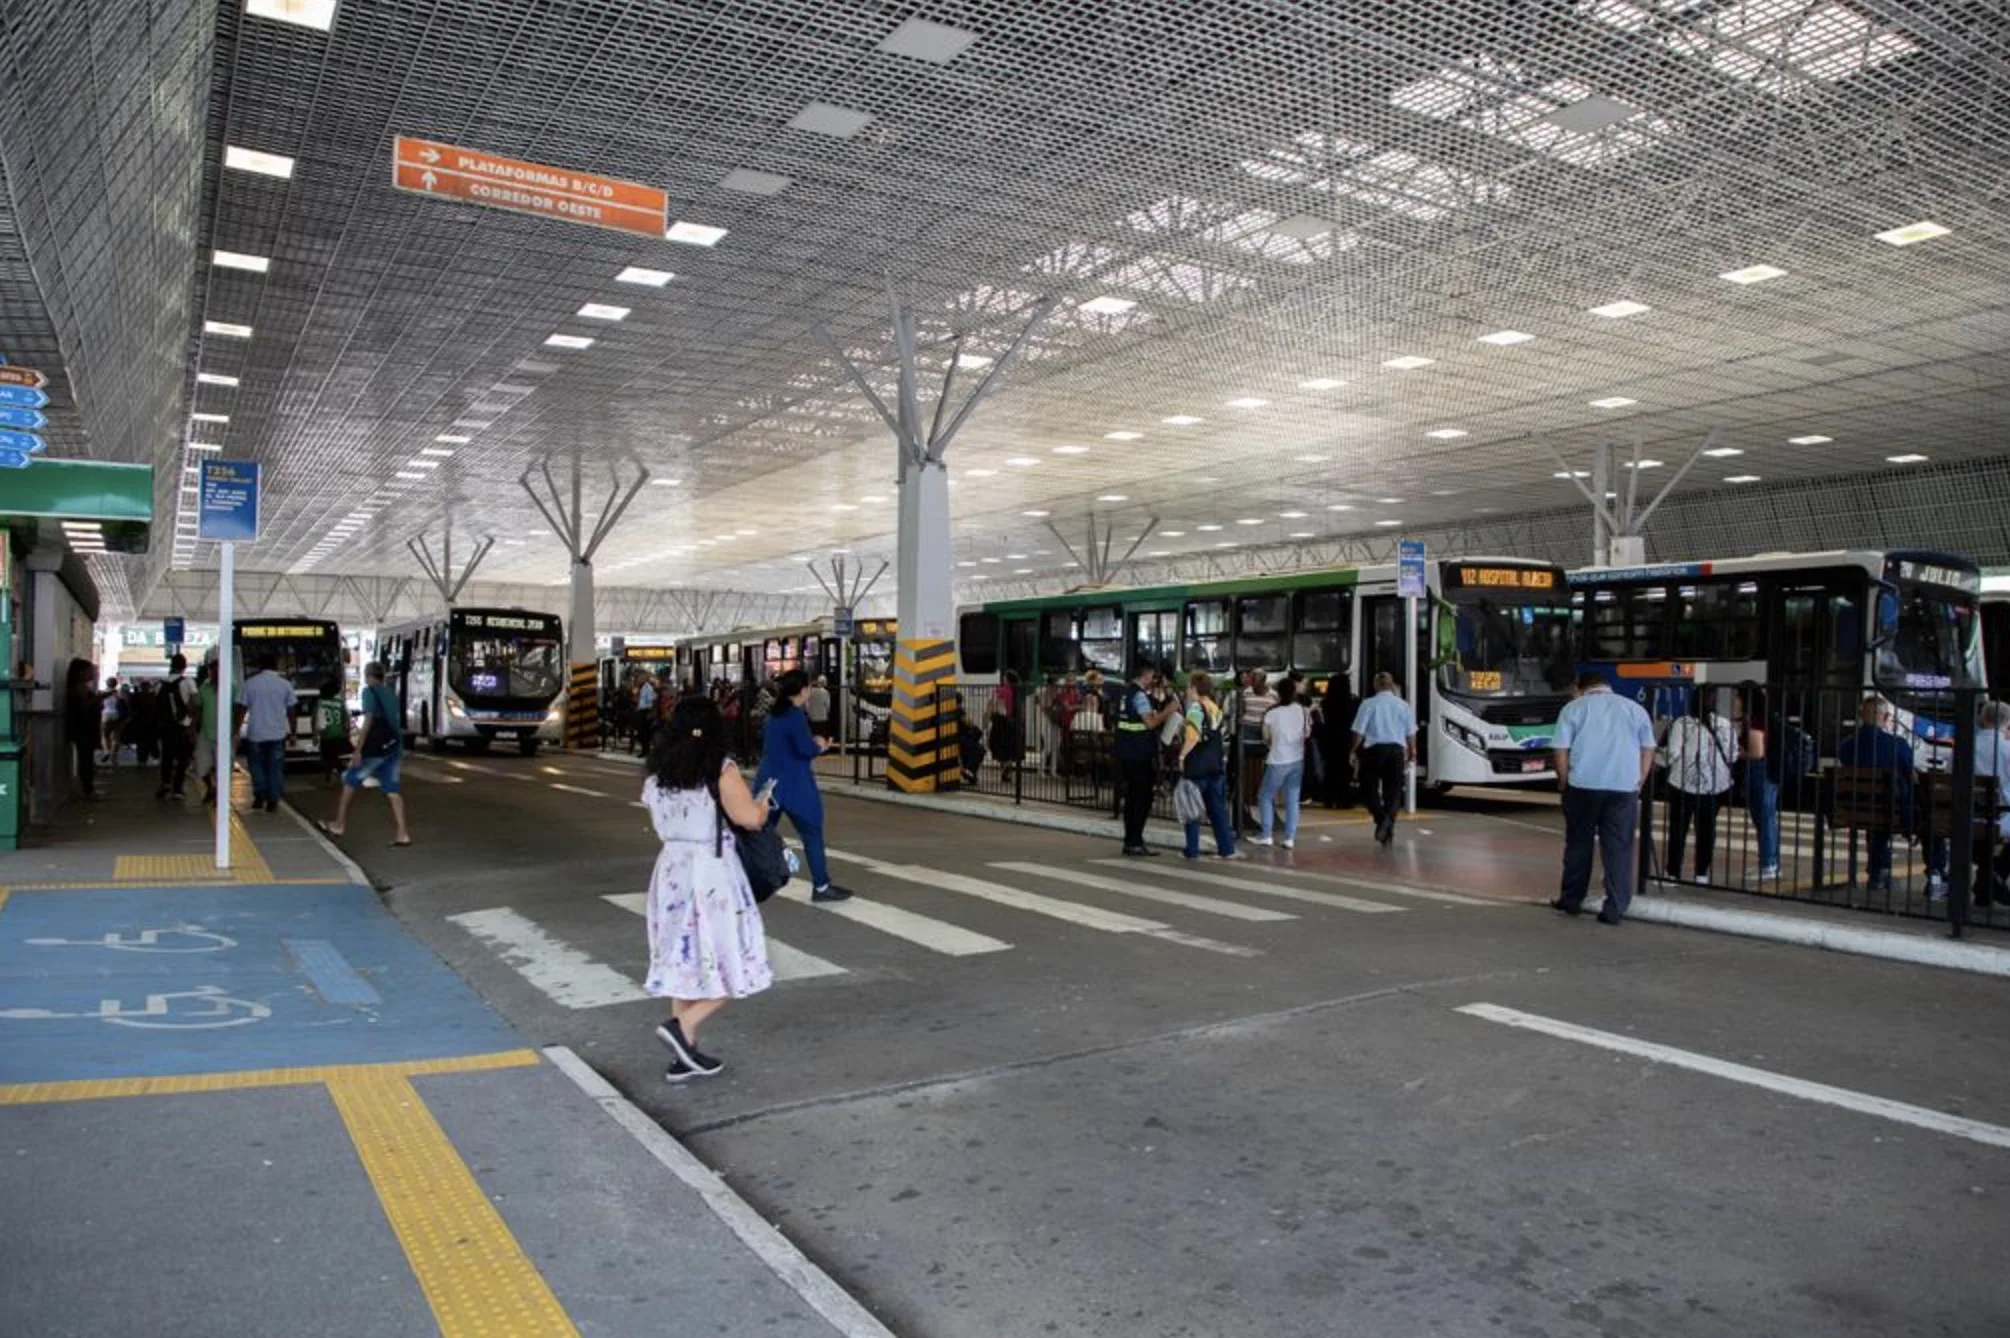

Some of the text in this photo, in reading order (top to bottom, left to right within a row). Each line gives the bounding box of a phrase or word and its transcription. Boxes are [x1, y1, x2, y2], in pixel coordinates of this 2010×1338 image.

[459, 156, 614, 198] PLATAFORMAS B/C/D
[470, 183, 601, 219] CORREDOR OESTE
